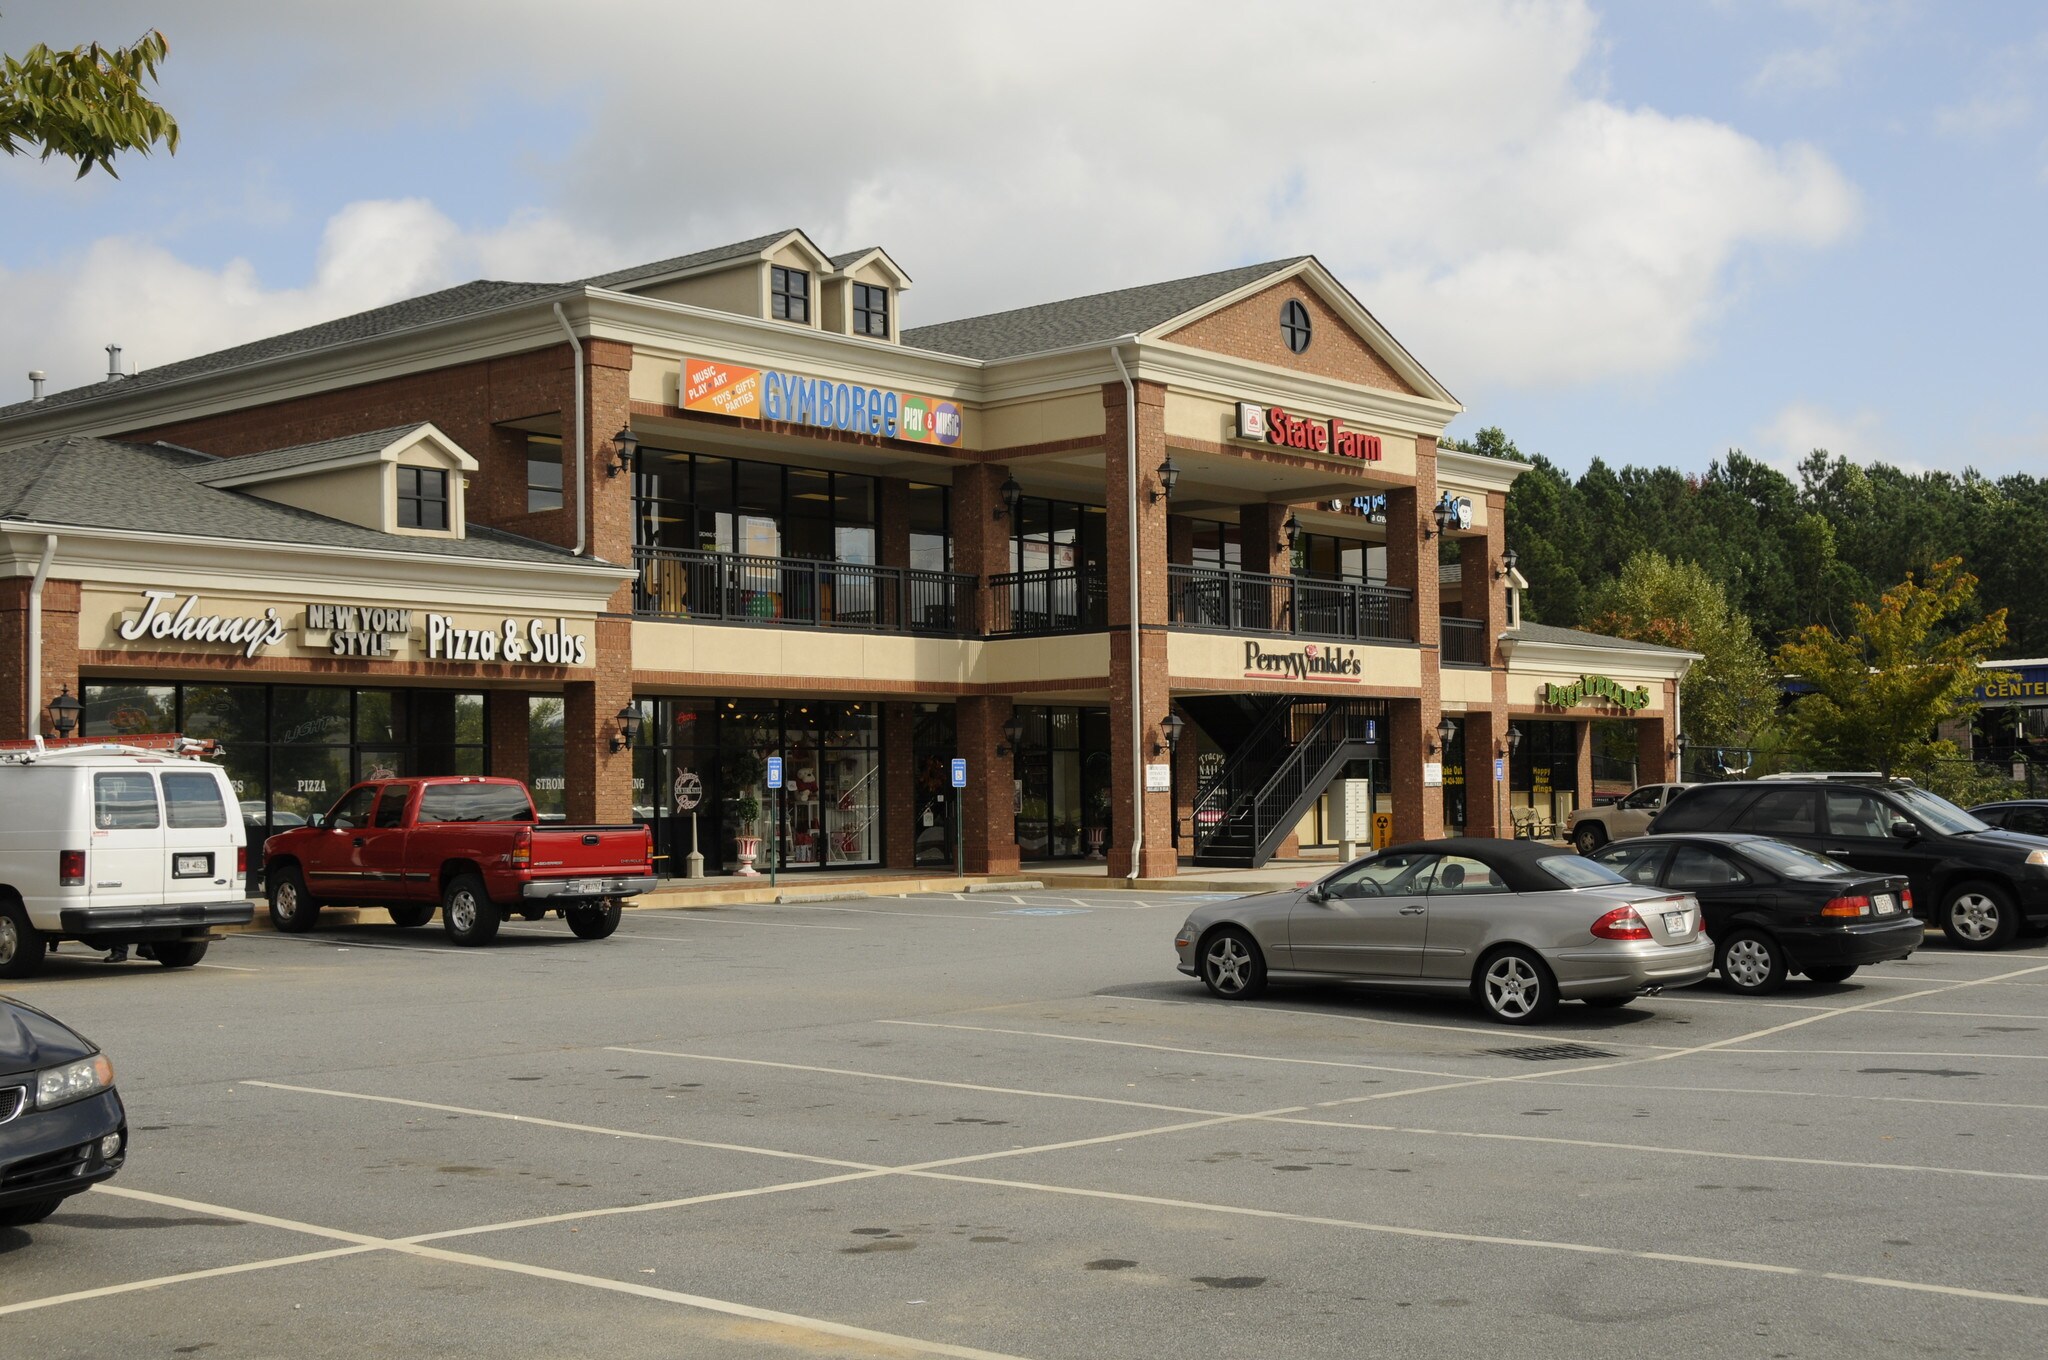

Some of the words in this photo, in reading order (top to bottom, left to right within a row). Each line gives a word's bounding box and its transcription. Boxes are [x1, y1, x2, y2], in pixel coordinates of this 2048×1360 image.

[692, 365, 716, 384] MUSIC
[688, 382, 708, 400] PLAY
[713, 372, 728, 388] ART
[712, 390, 731, 407] TOYS
[735, 377, 756, 395] GIFTS
[725, 391, 754, 413] PARTIES
[927, 413, 933, 429] &
[1266, 406, 1327, 452] State
[1328, 418, 1382, 461] Farm
[119, 590, 288, 659] Johnny's
[306, 604, 355, 630] NEW
[357, 607, 413, 632] YORK
[331, 631, 390, 657] STYLE
[426, 613, 496, 661] Pizza
[502, 618, 523, 662] &
[528, 617, 586, 665] Subs
[1244, 640, 1361, 680] PerryWinkle's
[1545, 680, 1584, 709] BEEF
[1199, 752, 1226, 766] Tracy's
[1453, 765, 1463, 776] Out
[1532, 766, 1550, 777] Happy
[1535, 776, 1549, 784] Hour
[297, 780, 327, 792] PIZZA
[535, 778, 565, 790] STROM
[1533, 785, 1553, 794] Wings
